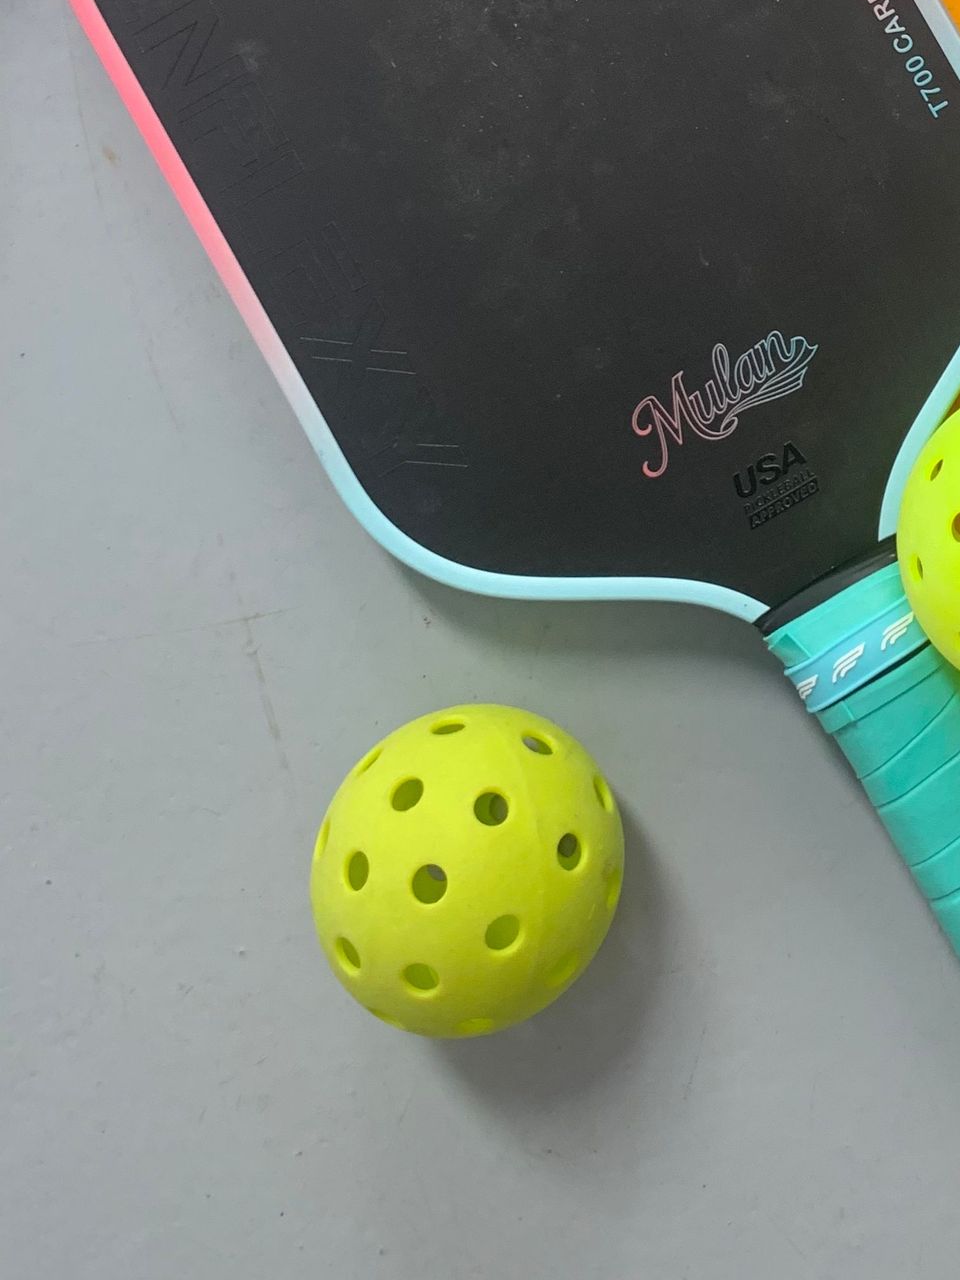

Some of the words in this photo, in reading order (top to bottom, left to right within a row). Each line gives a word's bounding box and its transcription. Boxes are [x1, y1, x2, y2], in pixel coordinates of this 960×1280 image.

[904, 55, 949, 119] T700
[632, 330, 818, 478] Mulan
[732, 440, 808, 499] USA
[750, 481, 819, 529] APPROVED
